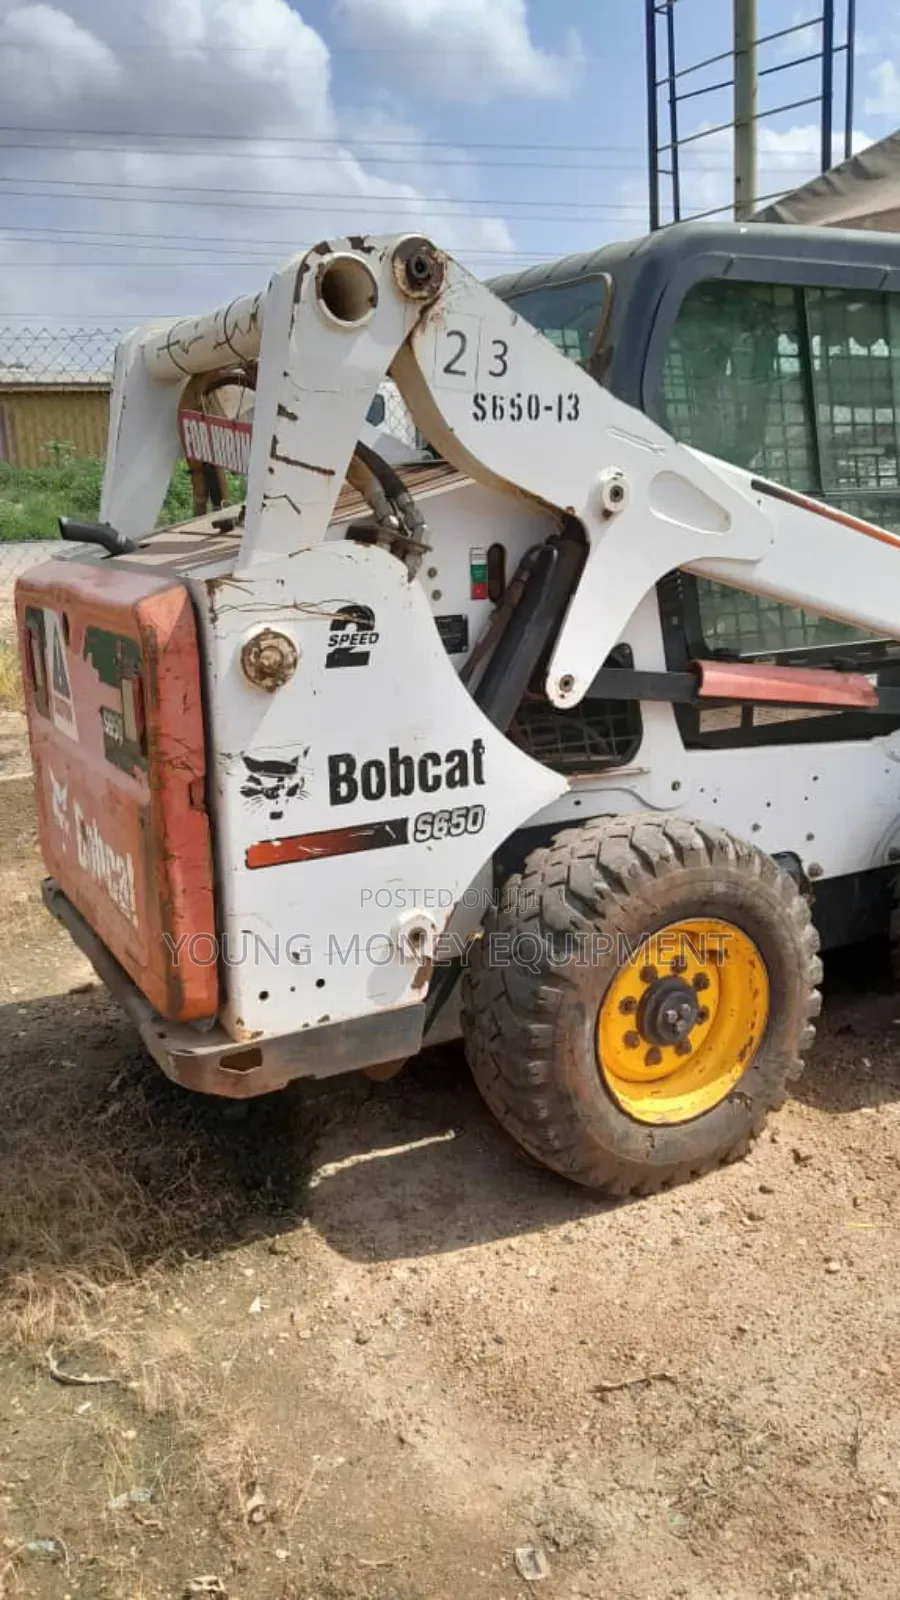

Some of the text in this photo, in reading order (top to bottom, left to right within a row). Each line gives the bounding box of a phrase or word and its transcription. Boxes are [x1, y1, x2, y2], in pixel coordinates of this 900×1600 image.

[472, 392, 580, 422] S650-13
[182, 418, 213, 463] FOR
[327, 631, 380, 648] SPEED
[327, 738, 486, 806] Bobcat
[413, 804, 485, 843] S650
